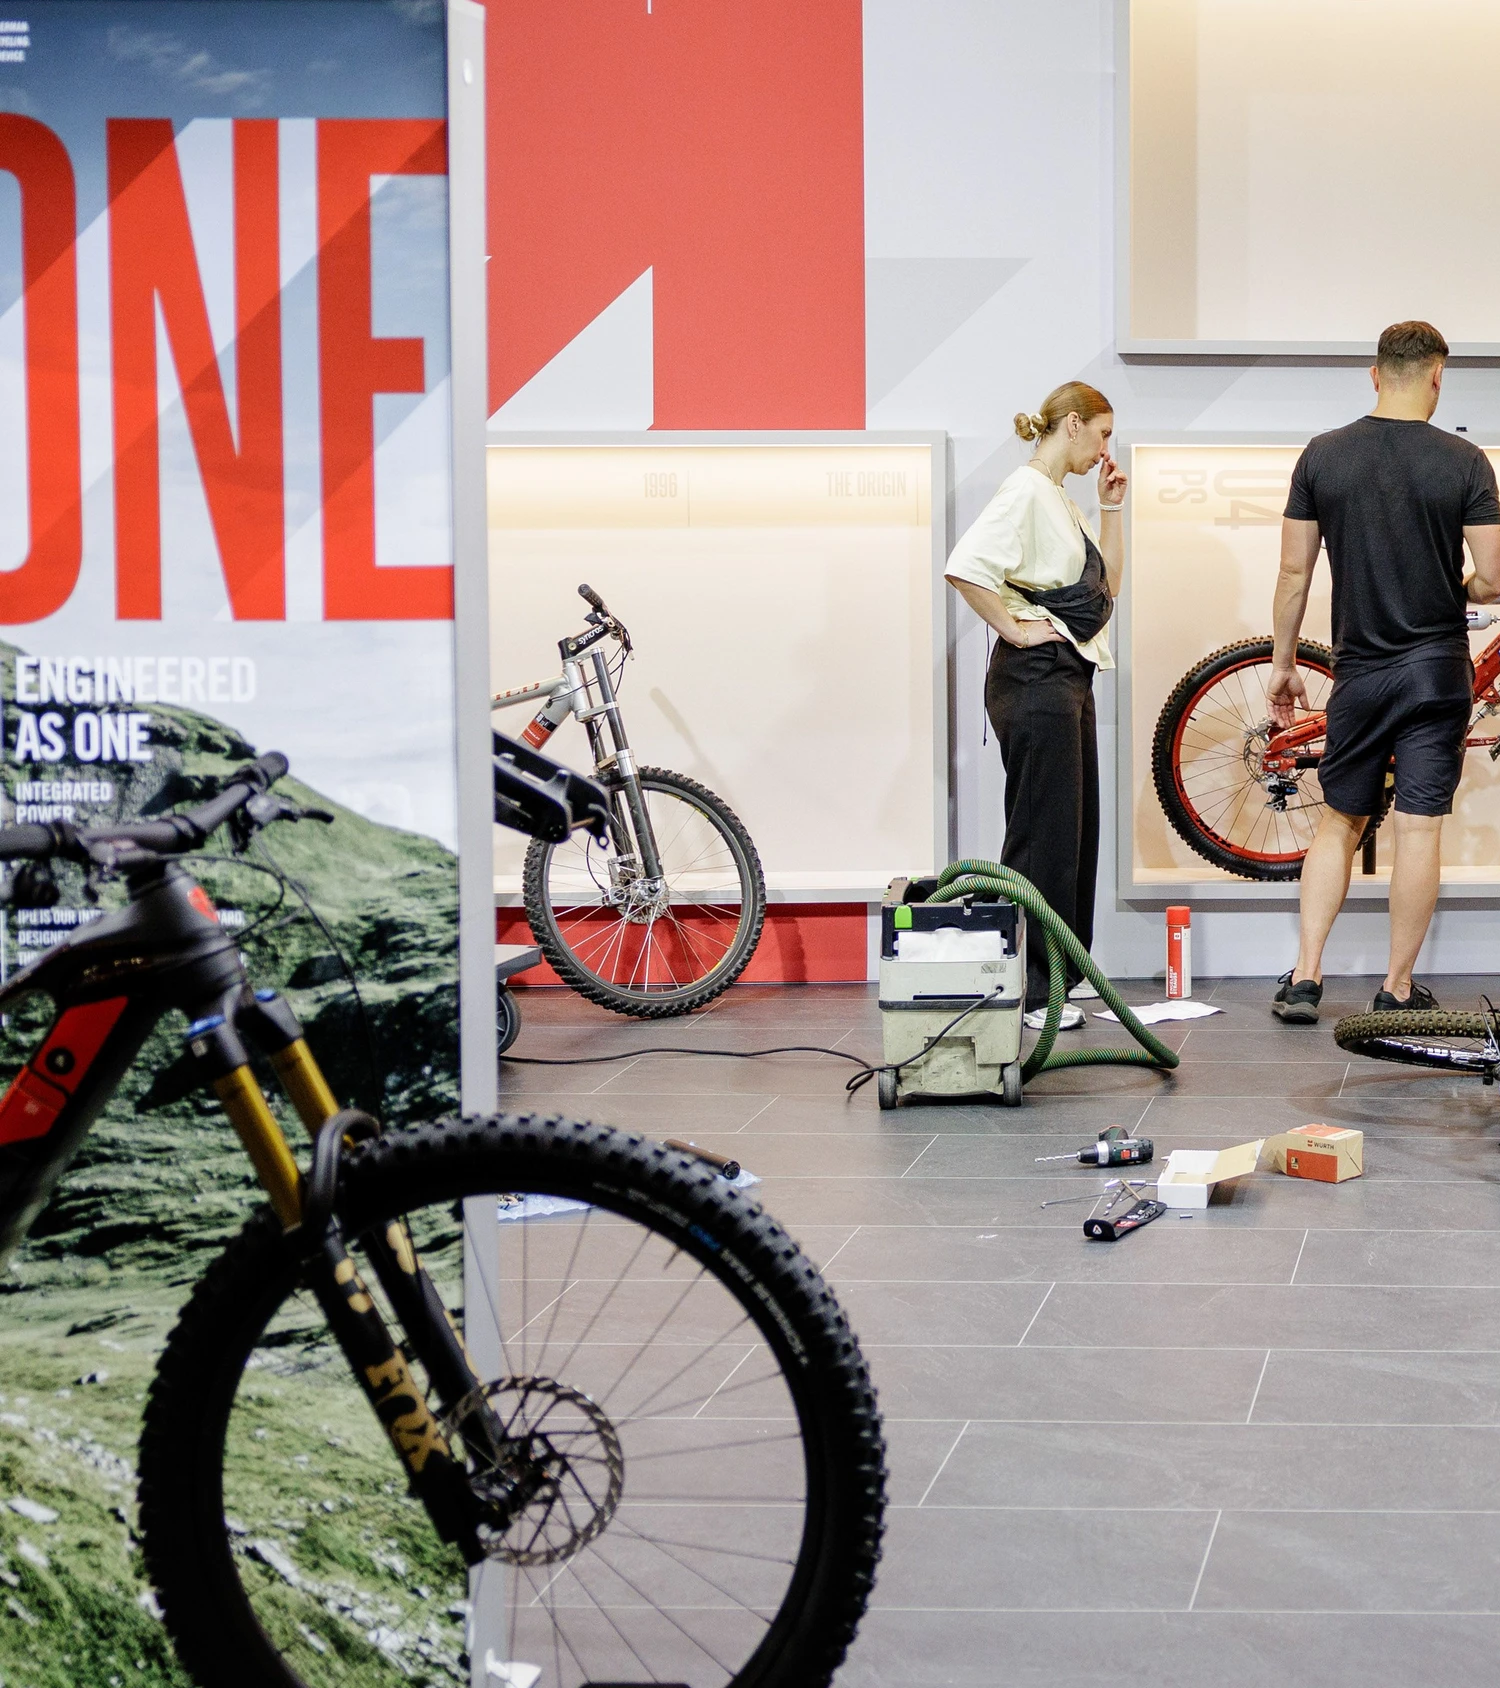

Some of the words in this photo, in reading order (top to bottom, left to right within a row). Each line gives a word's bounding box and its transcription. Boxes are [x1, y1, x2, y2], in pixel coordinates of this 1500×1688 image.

[643, 472, 678, 498] 1996
[826, 471, 852, 497] THE
[857, 471, 907, 497] ORIGIN
[15, 656, 257, 703] ENGINEERED
[15, 713, 66, 761] AS
[74, 713, 153, 761] ONE
[16, 781, 113, 801] INTEGRATED
[16, 804, 76, 824] POWER
